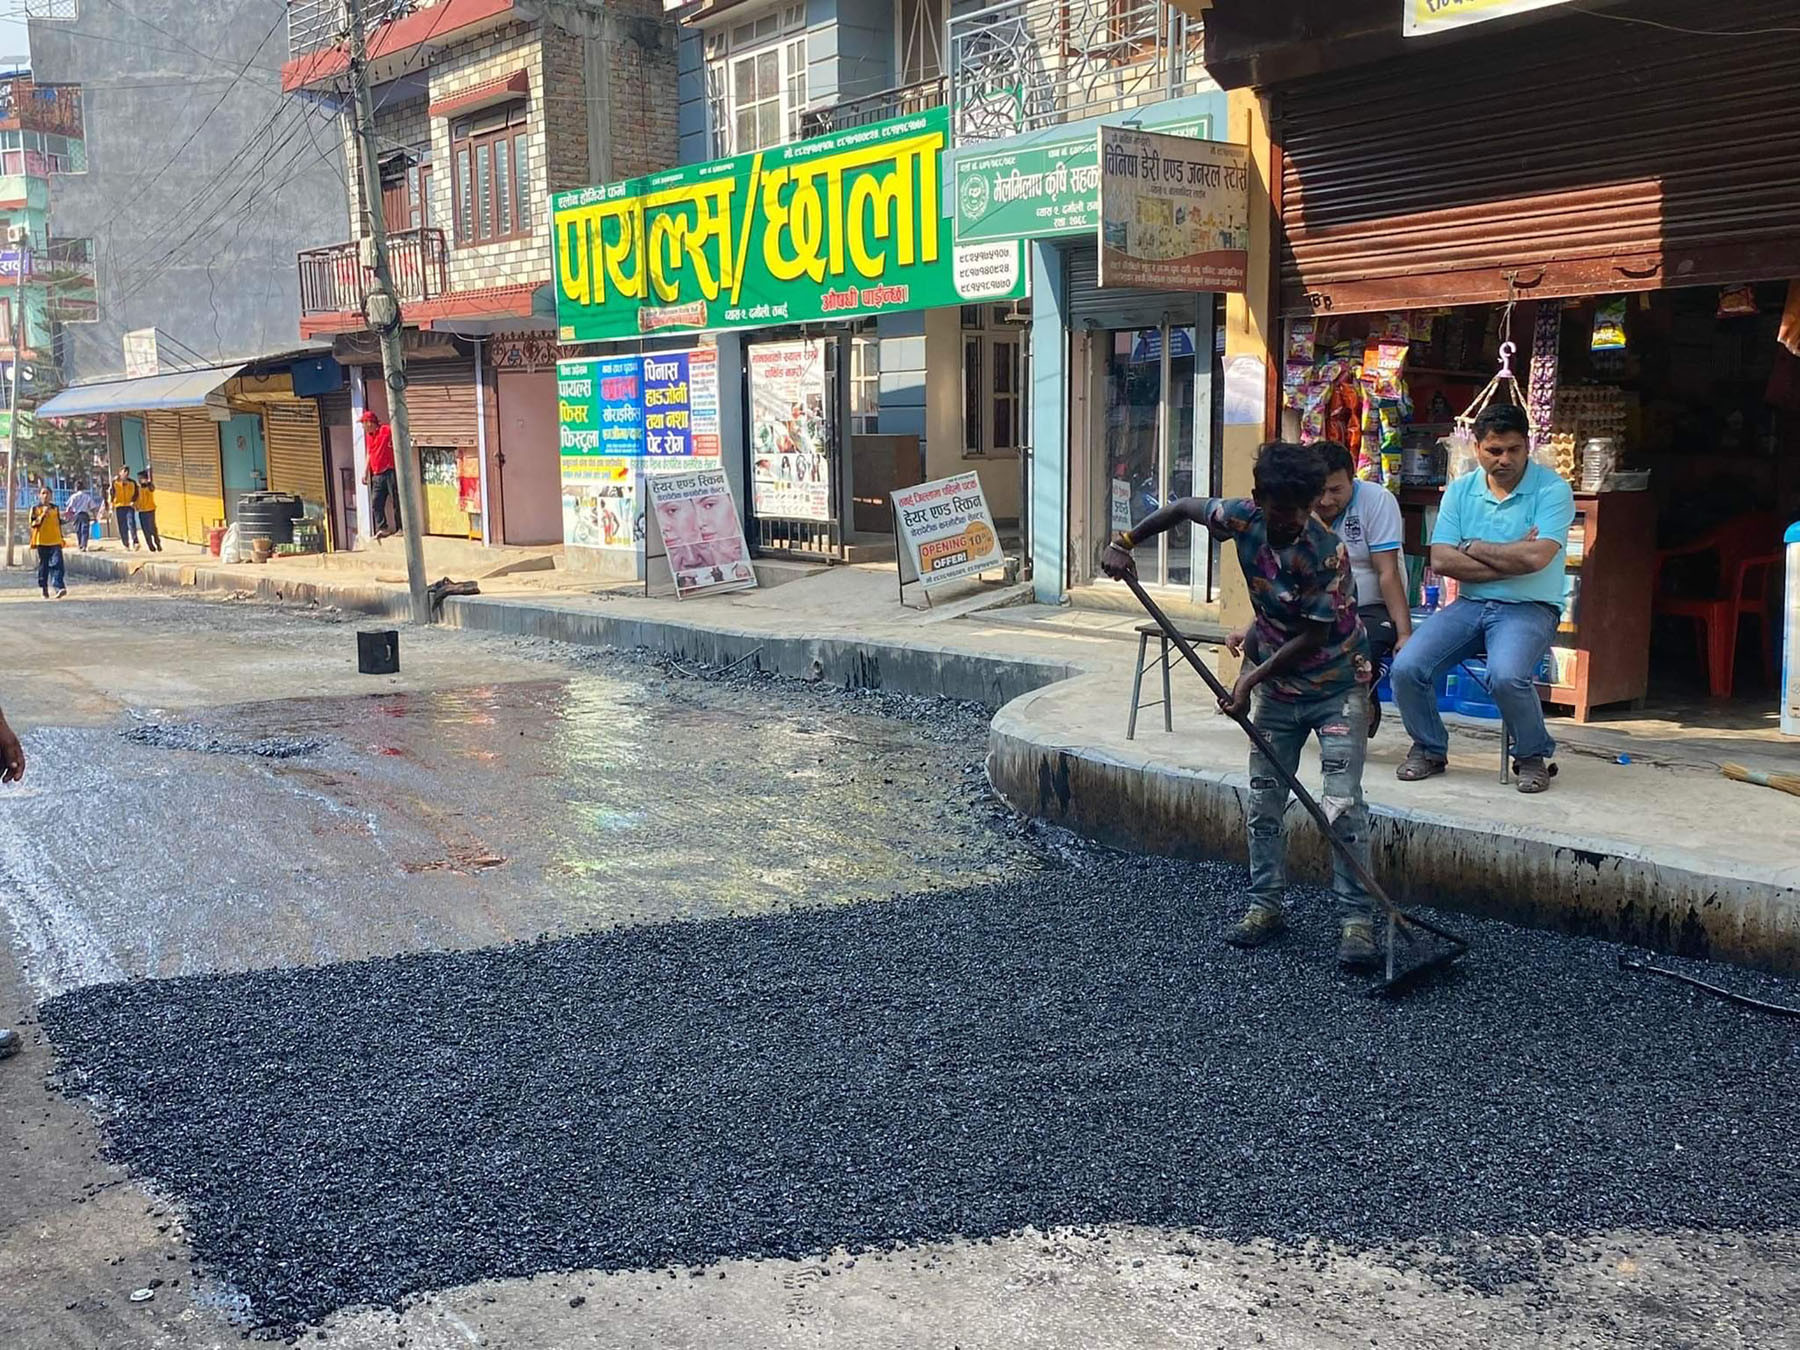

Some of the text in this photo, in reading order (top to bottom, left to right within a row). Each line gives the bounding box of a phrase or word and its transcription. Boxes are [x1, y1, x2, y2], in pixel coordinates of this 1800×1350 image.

[1141, 147, 1161, 181] डेरी
[1163, 159, 1184, 182] एण्ड
[1186, 161, 1221, 188] जनरल
[1045, 161, 1068, 202] कृषि
[555, 132, 944, 306] पायल्स/छाला
[644, 358, 679, 382] पिनास
[558, 379, 592, 397] पायल्स
[560, 400, 589, 423] फिसर
[646, 413, 665, 430] तथा
[647, 431, 663, 454] पेट
[664, 430, 684, 454] रोग
[652, 475, 725, 493] हेयर एण्ड स्किन
[903, 495, 982, 527] हेयर एण्ड स्किन
[922, 536, 968, 557] OPENING
[933, 551, 967, 568] OFFER!
